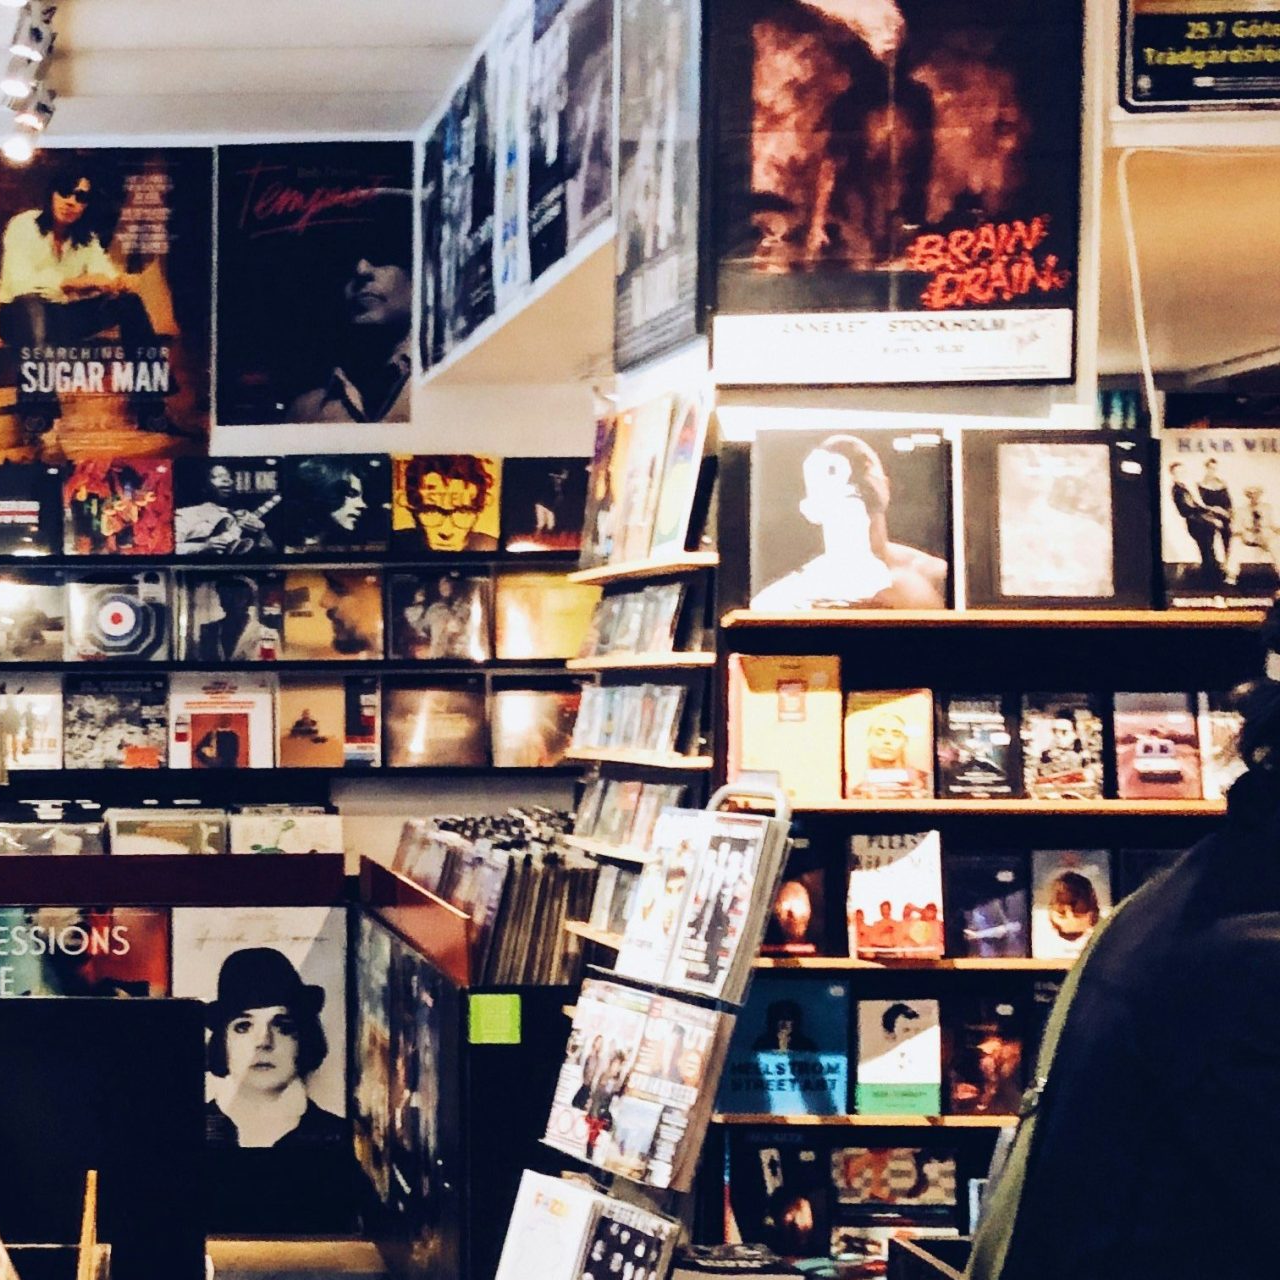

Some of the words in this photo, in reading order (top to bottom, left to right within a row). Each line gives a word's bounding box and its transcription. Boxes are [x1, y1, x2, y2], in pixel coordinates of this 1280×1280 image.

[904, 214, 1051, 272] BRAIN
[920, 254, 1070, 311] DRAIN
[887, 318, 1007, 333] STOCKHOLM
[21, 347, 124, 361] SEARCHING
[137, 347, 170, 360] FOR
[21, 361, 104, 393] SUGAR
[111, 361, 170, 393] MAN
